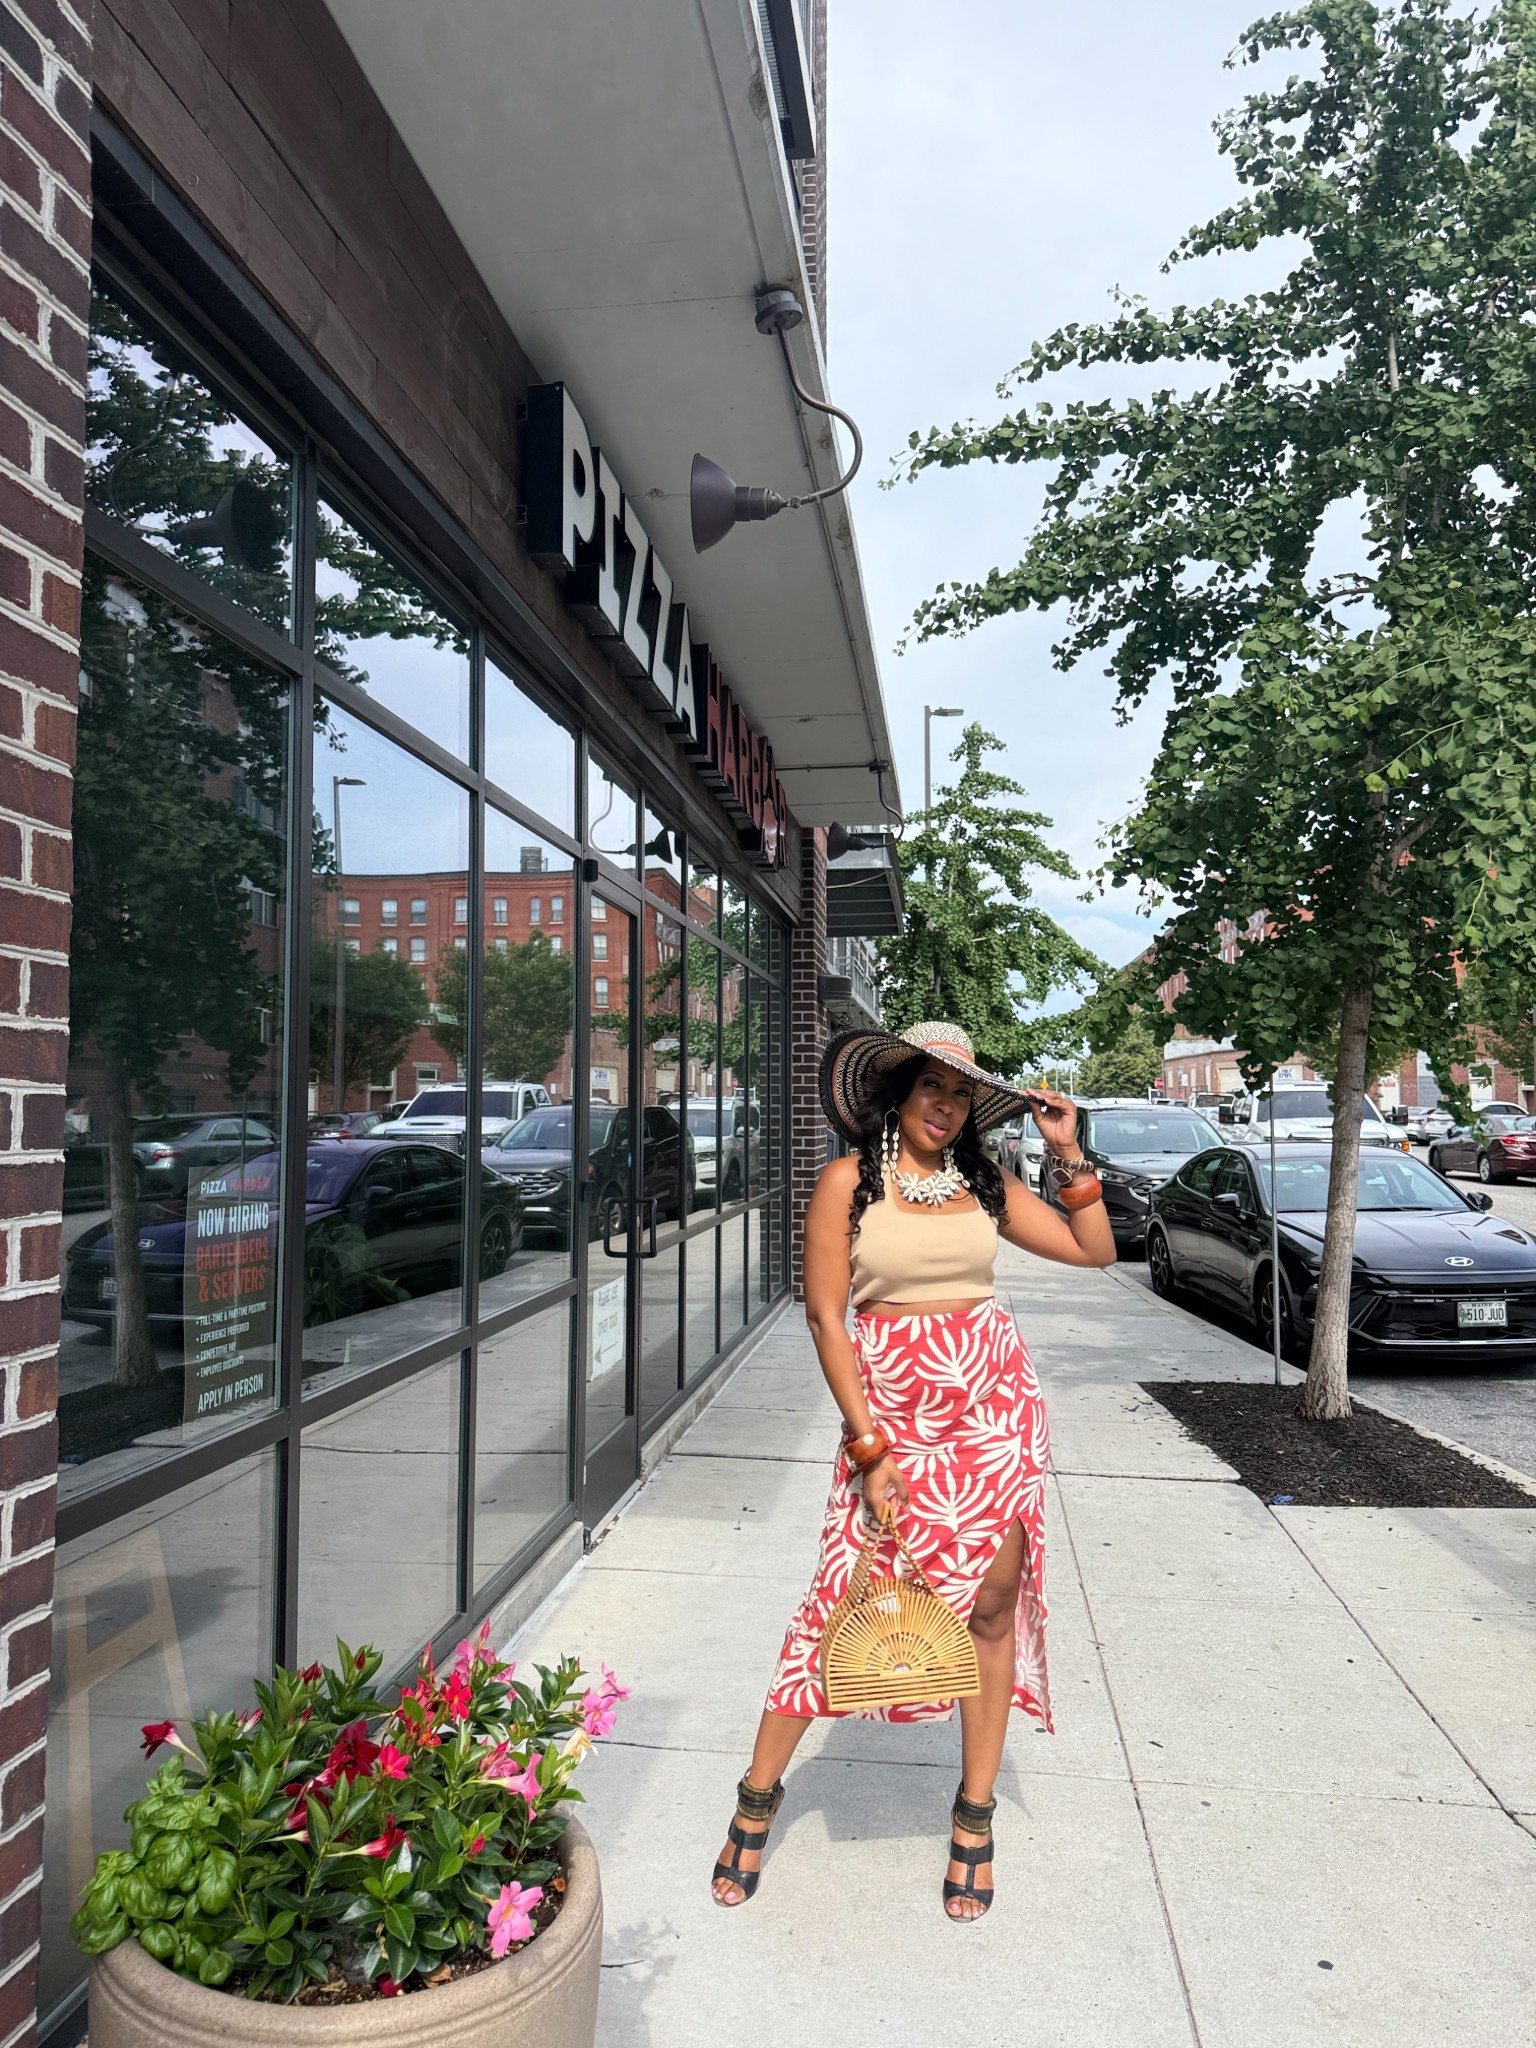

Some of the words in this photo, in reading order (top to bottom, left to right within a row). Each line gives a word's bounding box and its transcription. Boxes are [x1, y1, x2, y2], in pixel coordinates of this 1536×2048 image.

[560, 381, 699, 744] PIZZA
[200, 1179, 227, 1195] PIZZA
[197, 1207, 226, 1238] NOW
[228, 1202, 269, 1234] HIRING
[196, 1236, 269, 1272] BARTENDERS
[199, 1275, 209, 1303] &
[212, 1264, 266, 1300] SERVERS
[200, 1311, 224, 1327] FULL-TIME
[228, 1305, 248, 1319] PART-TIME
[248, 1301, 267, 1314] POSITIONS
[200, 1327, 227, 1344] EXPERIENCE
[227, 1321, 250, 1337] PREFERRED
[200, 1343, 228, 1361] COMPETITIVE
[228, 1341, 237, 1353] PAY
[200, 1361, 223, 1378] EMPLOYEE
[222, 1355, 245, 1371] DISCOUNTS
[197, 1386, 223, 1414] APPLY
[224, 1383, 233, 1404] IN
[234, 1372, 264, 1400] PERSON
